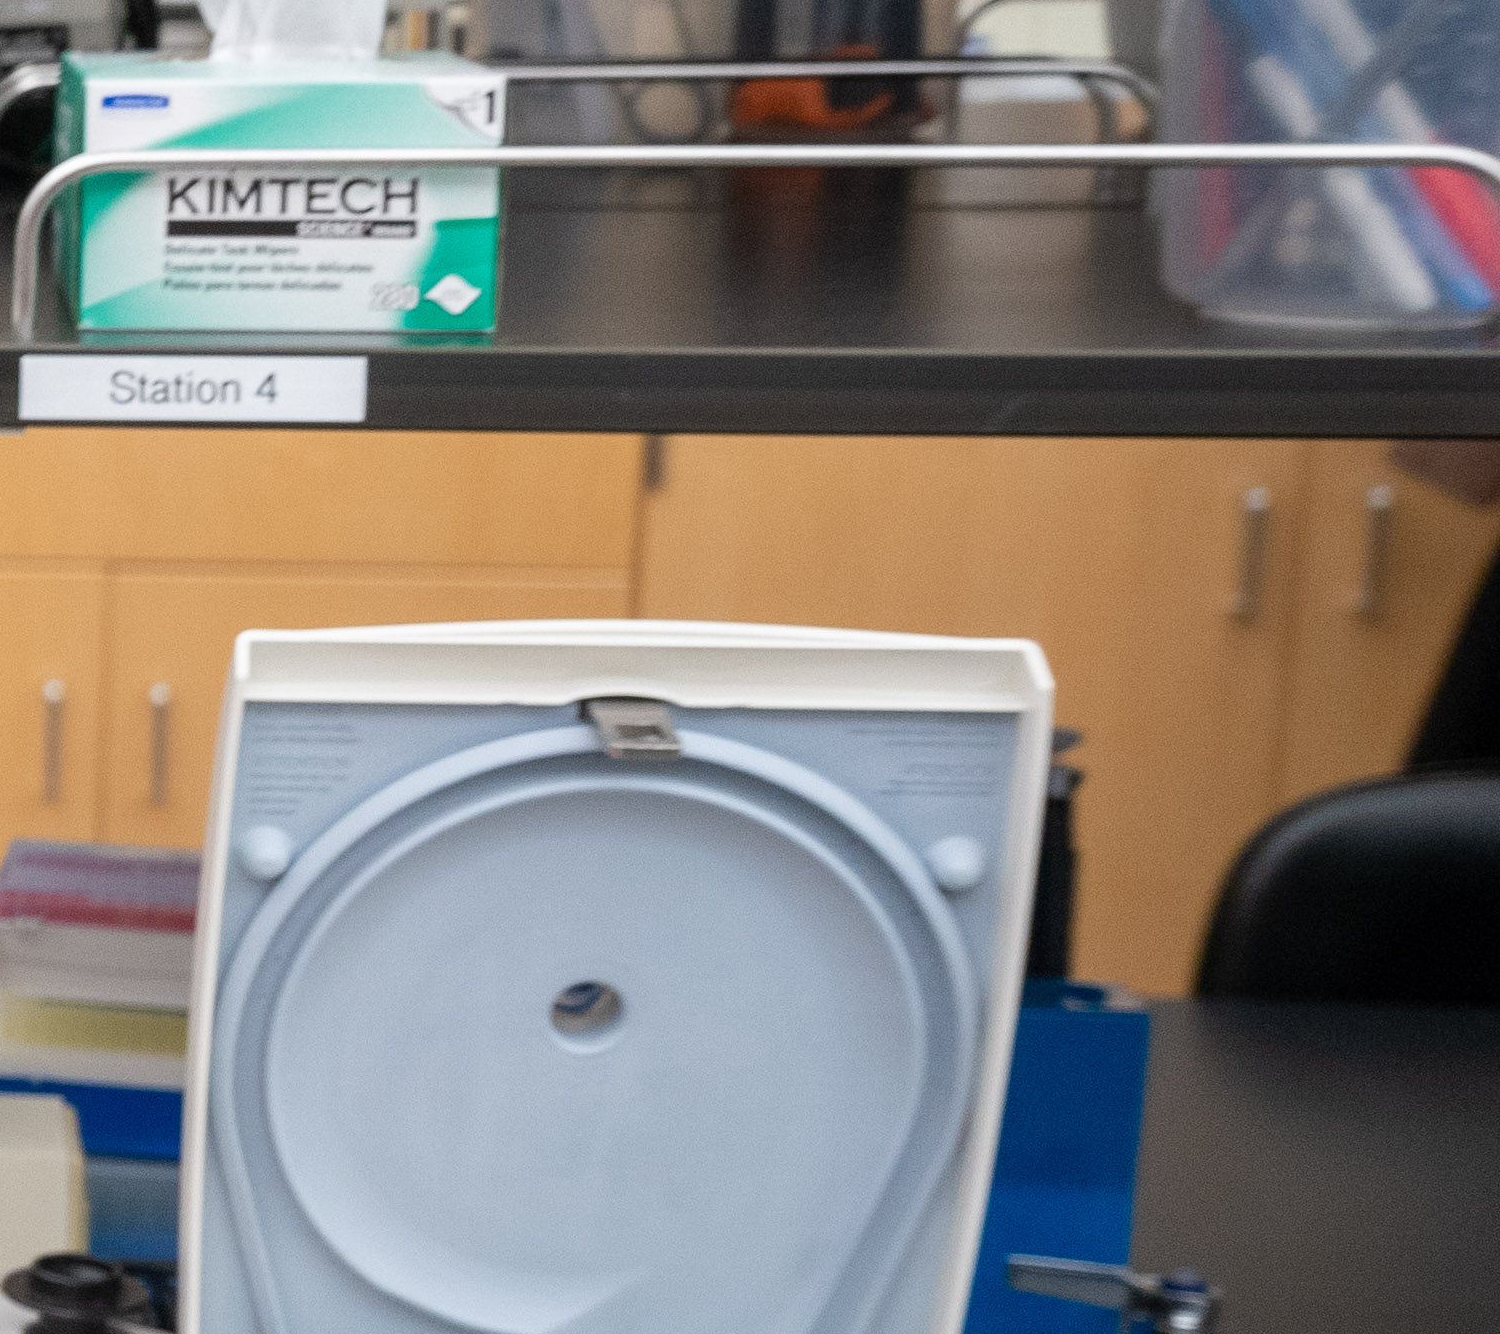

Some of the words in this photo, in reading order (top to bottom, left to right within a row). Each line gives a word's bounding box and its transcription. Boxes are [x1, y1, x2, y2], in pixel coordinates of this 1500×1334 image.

[166, 177, 420, 215] KIMTECH
[108, 370, 242, 406] Station
[255, 371, 279, 403] 4
